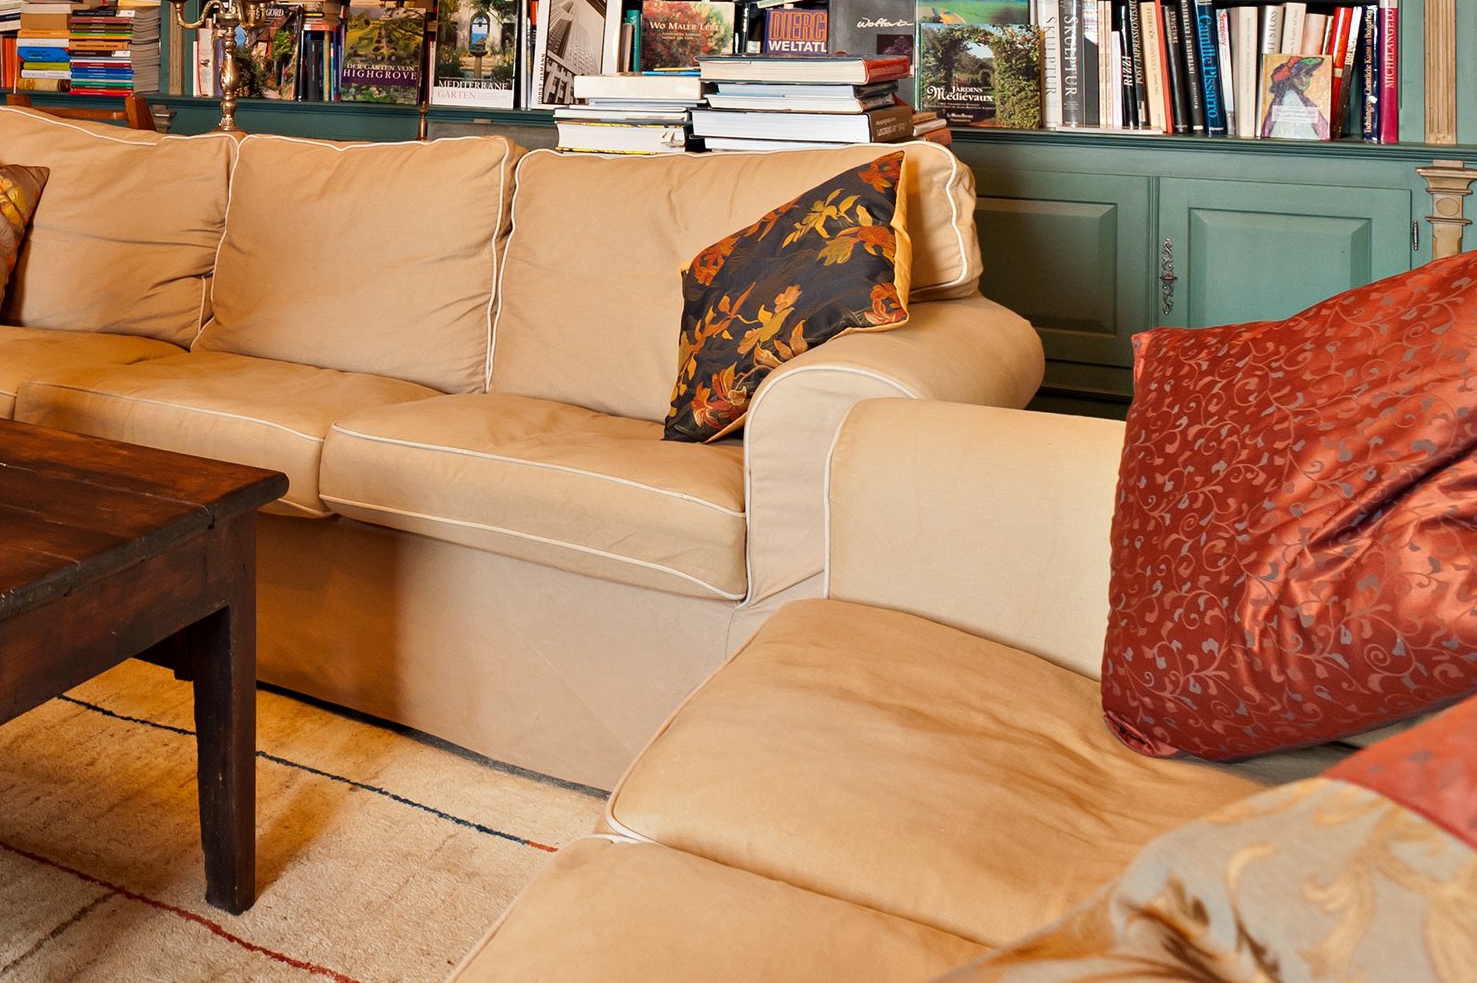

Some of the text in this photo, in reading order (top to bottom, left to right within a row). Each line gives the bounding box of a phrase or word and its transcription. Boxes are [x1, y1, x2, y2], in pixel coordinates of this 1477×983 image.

[769, 11, 828, 42] DIERC
[1146, 7, 1156, 40] AQUARELLE
[1170, 11, 1178, 44] STRUCTURE
[1267, 10, 1277, 37] STOSS
[1045, 16, 1058, 96] SKULPTUR
[1063, 16, 1079, 97] SKULPTUR
[1186, 39, 1195, 74] INTERIEUR
[1364, 47, 1372, 63] Kunst
[1384, 8, 1395, 88] MICHELANGELO
[343, 69, 418, 81] HIGHGROVE
[365, 63, 395, 71] GARTEN
[1122, 55, 1133, 86] RIZZI
[1199, 15, 1218, 118] Camille Pissarro
[1364, 65, 1373, 95] Christliche
[438, 80, 509, 90] MEDITERRANE
[926, 85, 994, 102] Médiévaux
[952, 85, 983, 94] JARDINS
